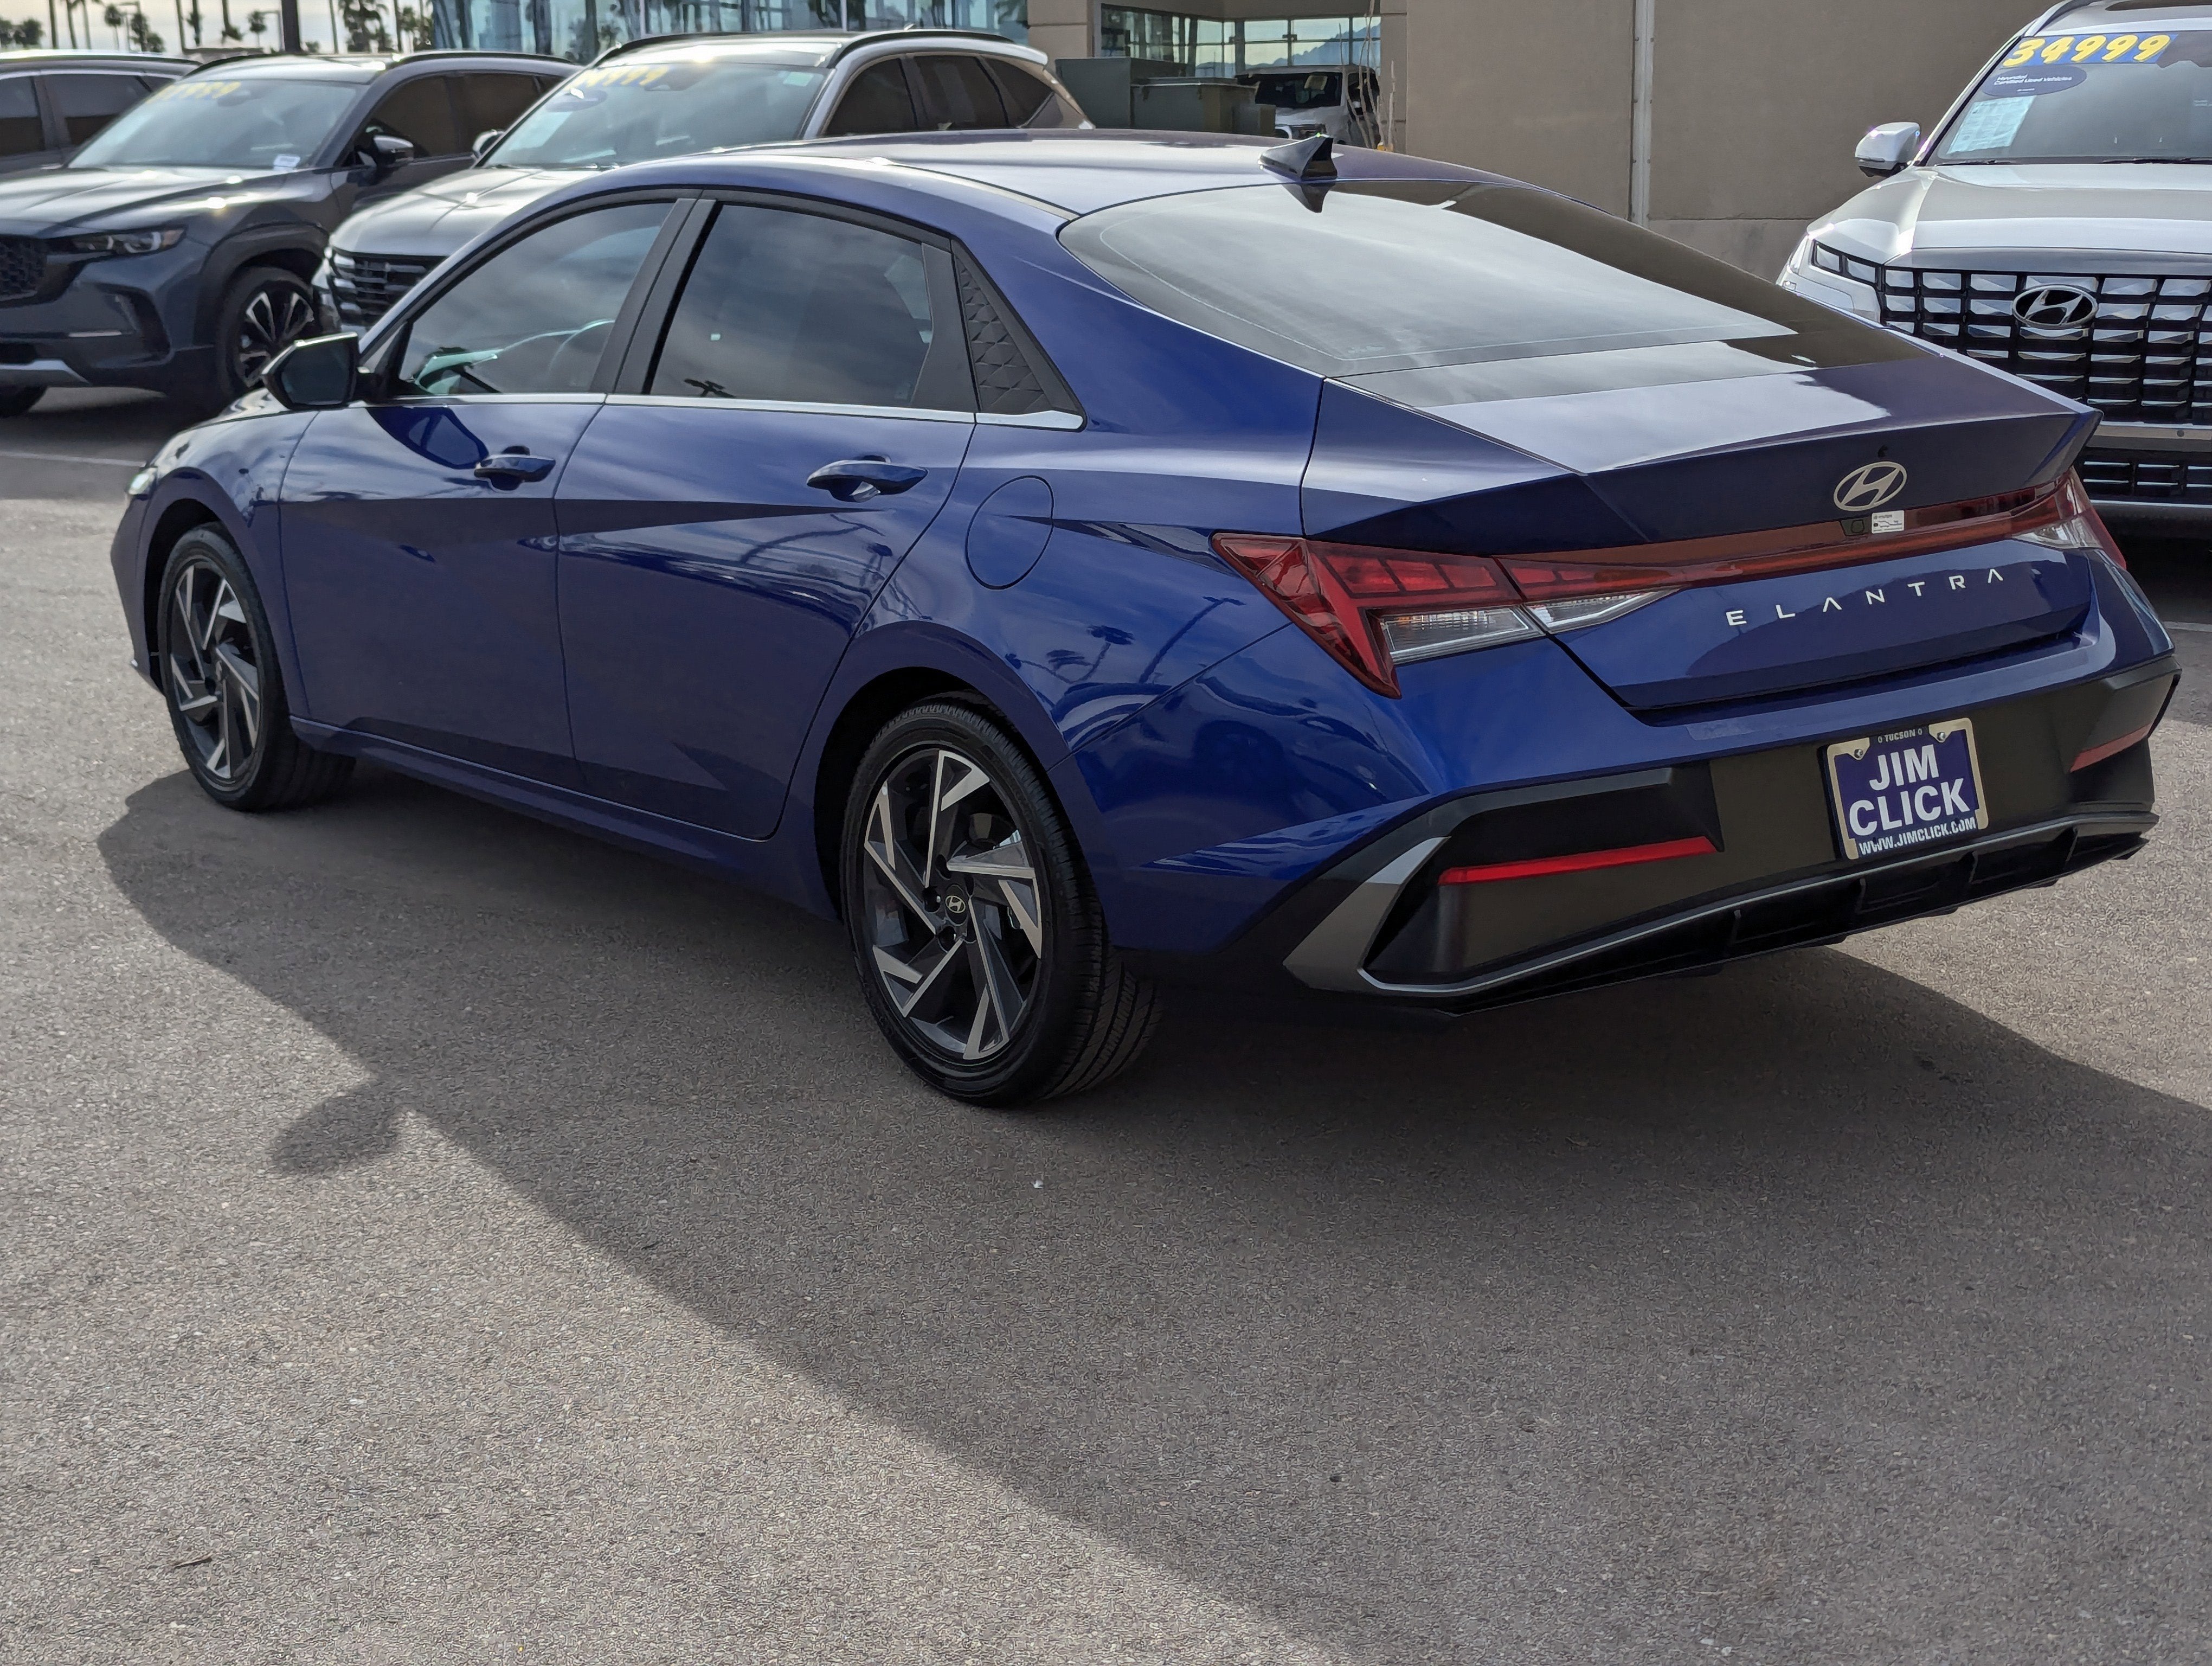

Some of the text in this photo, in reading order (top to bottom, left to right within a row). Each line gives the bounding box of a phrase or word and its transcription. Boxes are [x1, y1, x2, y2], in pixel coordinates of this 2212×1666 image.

[2002, 35, 2171, 68] 34999
[1725, 568, 2004, 626] ELANTRA
[1884, 729, 1916, 742] TUCSON
[1869, 744, 1939, 791] JIM
[1849, 778, 1971, 836] CLICK
[1859, 816, 1977, 856] WWW.JIMCLICK.COM
